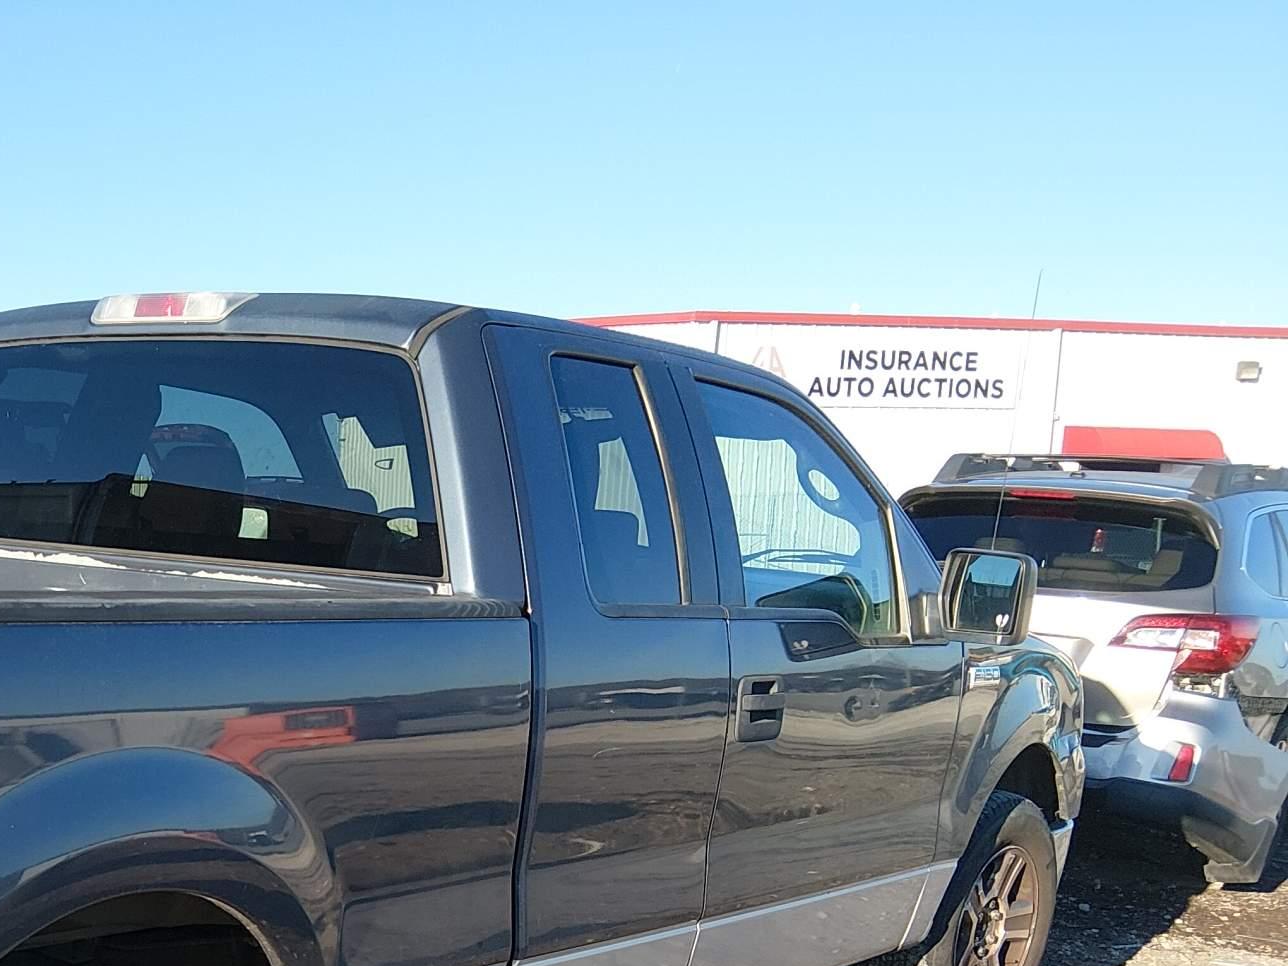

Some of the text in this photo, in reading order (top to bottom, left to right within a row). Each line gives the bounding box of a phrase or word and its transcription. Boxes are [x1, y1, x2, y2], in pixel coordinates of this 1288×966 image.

[839, 349, 979, 372] INSURANCE
[808, 376, 1005, 399] AUTO AUCTIONS
